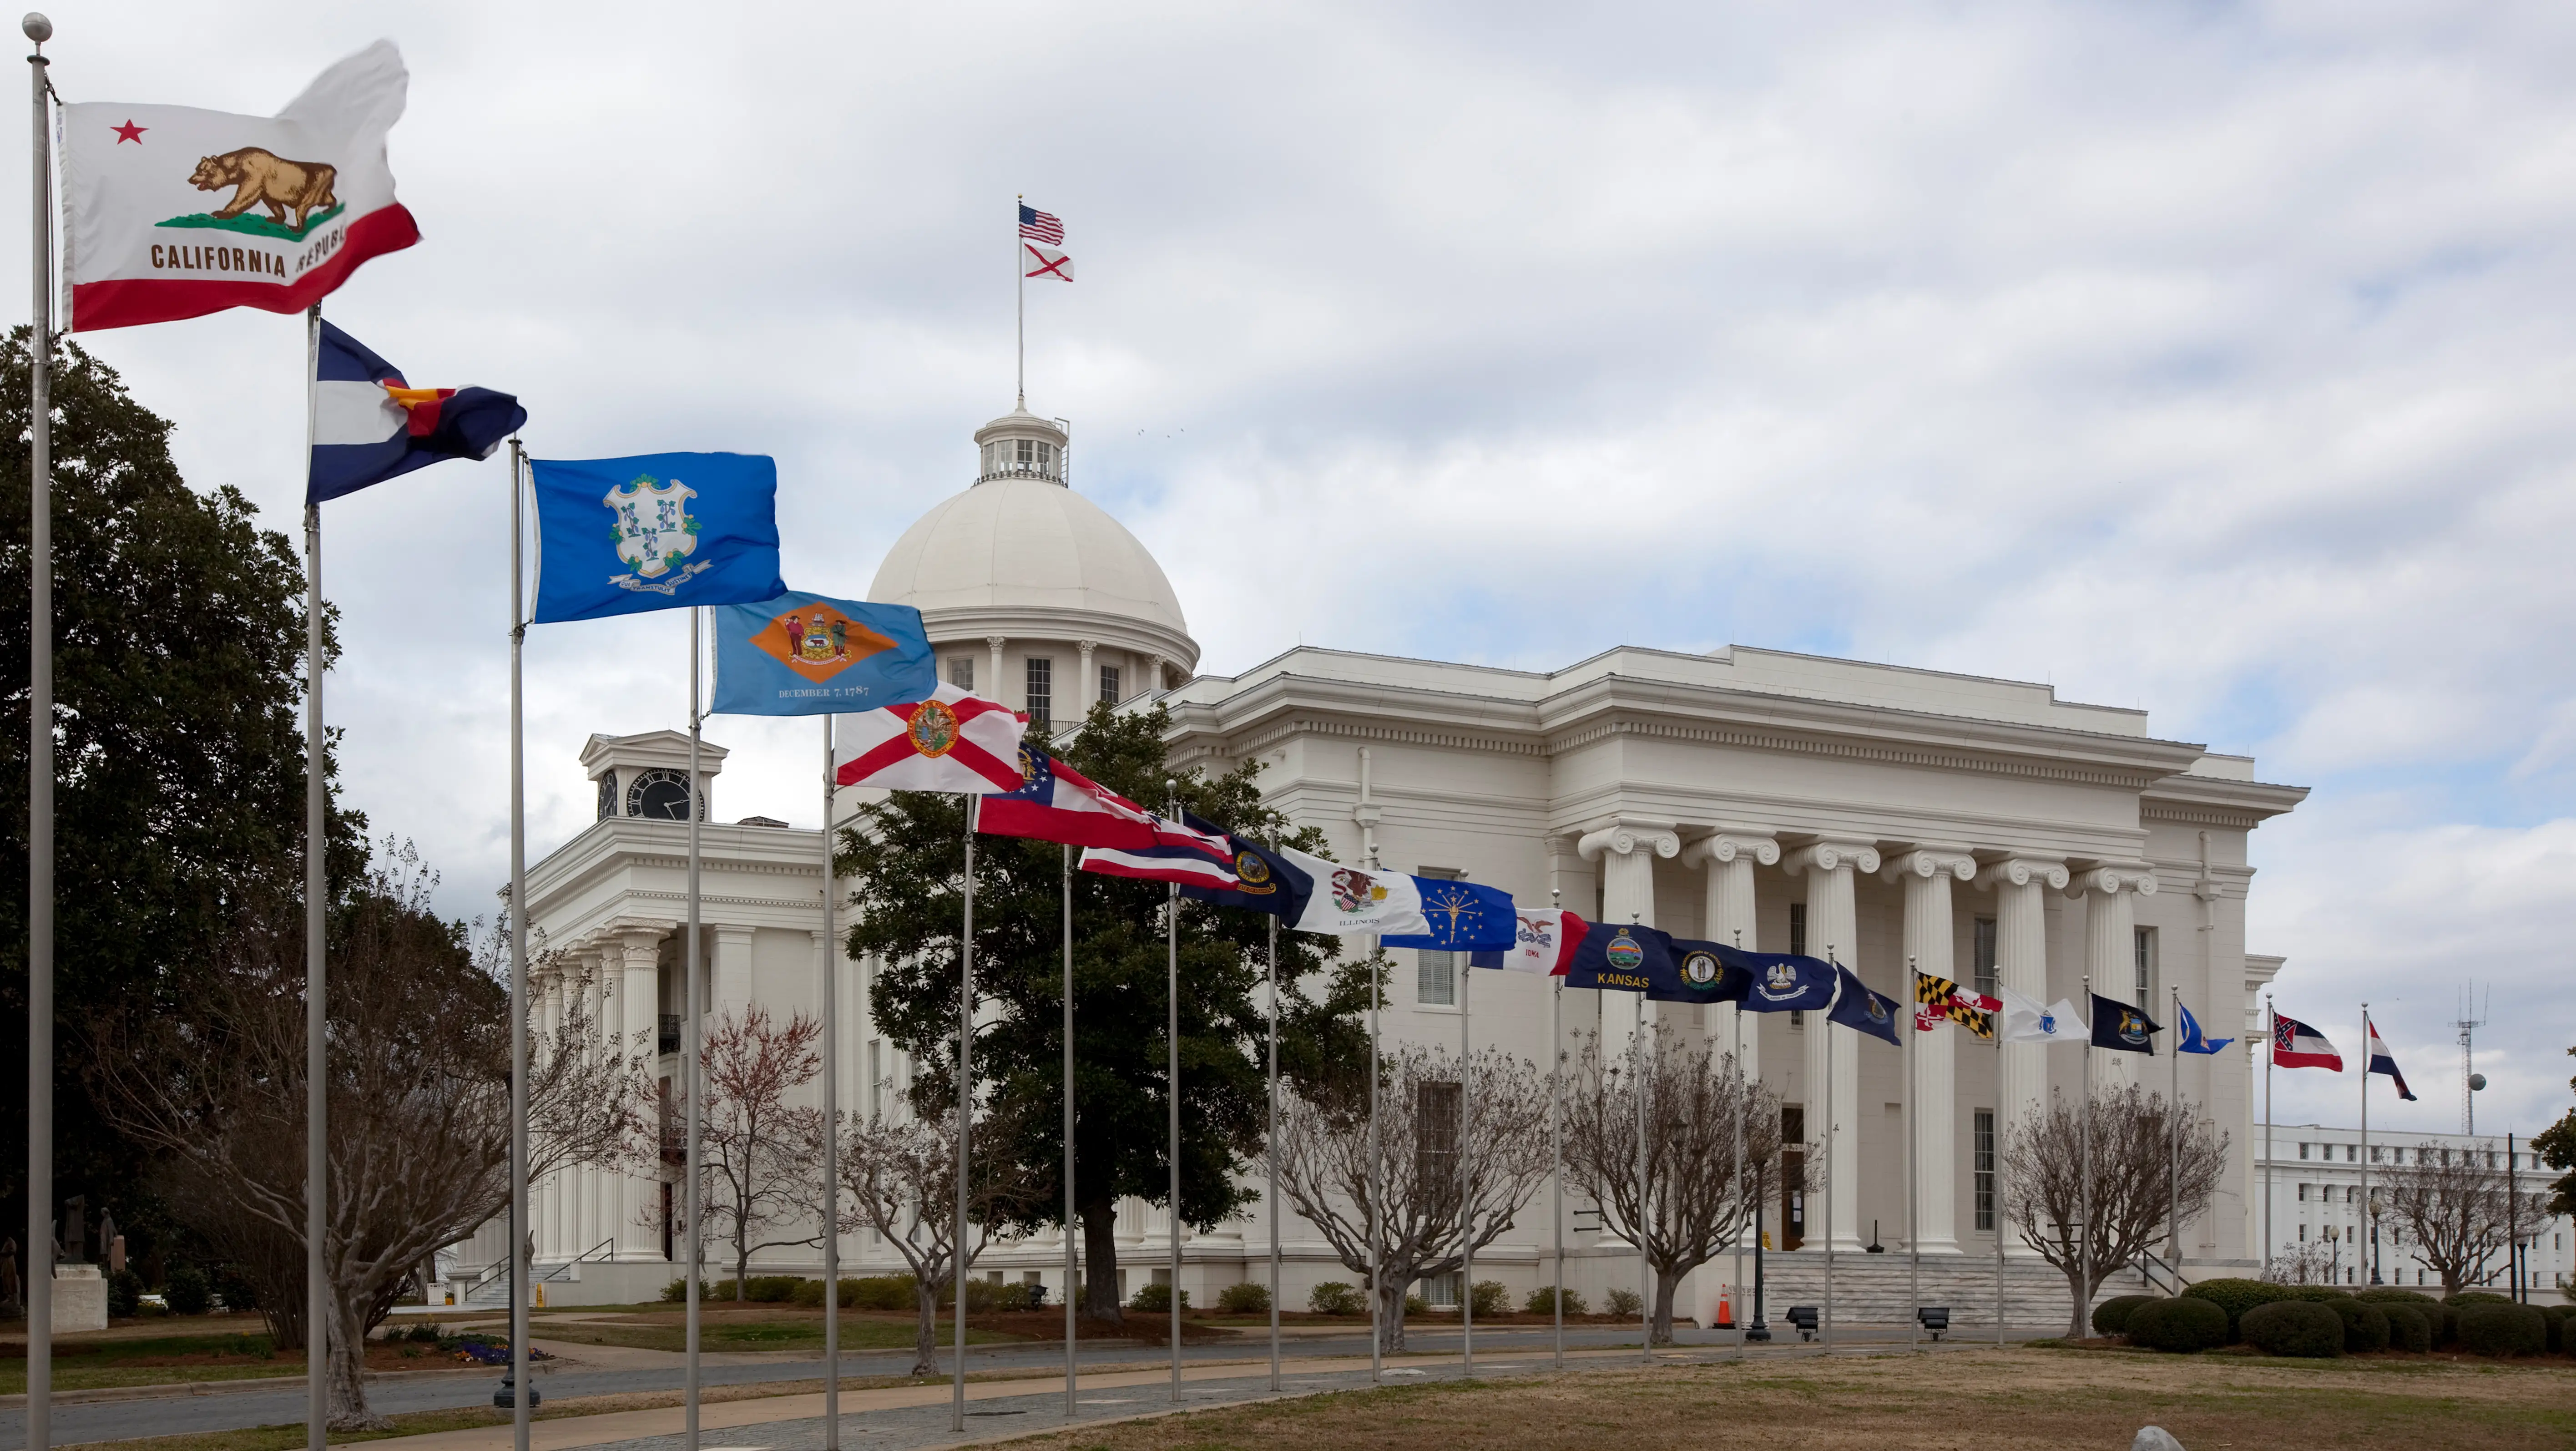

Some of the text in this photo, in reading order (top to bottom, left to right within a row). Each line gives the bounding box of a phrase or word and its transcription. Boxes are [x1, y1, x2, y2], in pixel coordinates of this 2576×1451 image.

[152, 225, 345, 278] CALIFORNIA REPUBL
[667, 572, 692, 586] SUSTINET
[779, 685, 869, 698] DECEMBER 7, 1787
[911, 711, 920, 721] SEAL
[934, 703, 949, 711] STATE
[1339, 918, 1379, 926] ILLINOIS
[1525, 949, 1539, 958] IOWA
[1598, 973, 1649, 988] KANSAS
